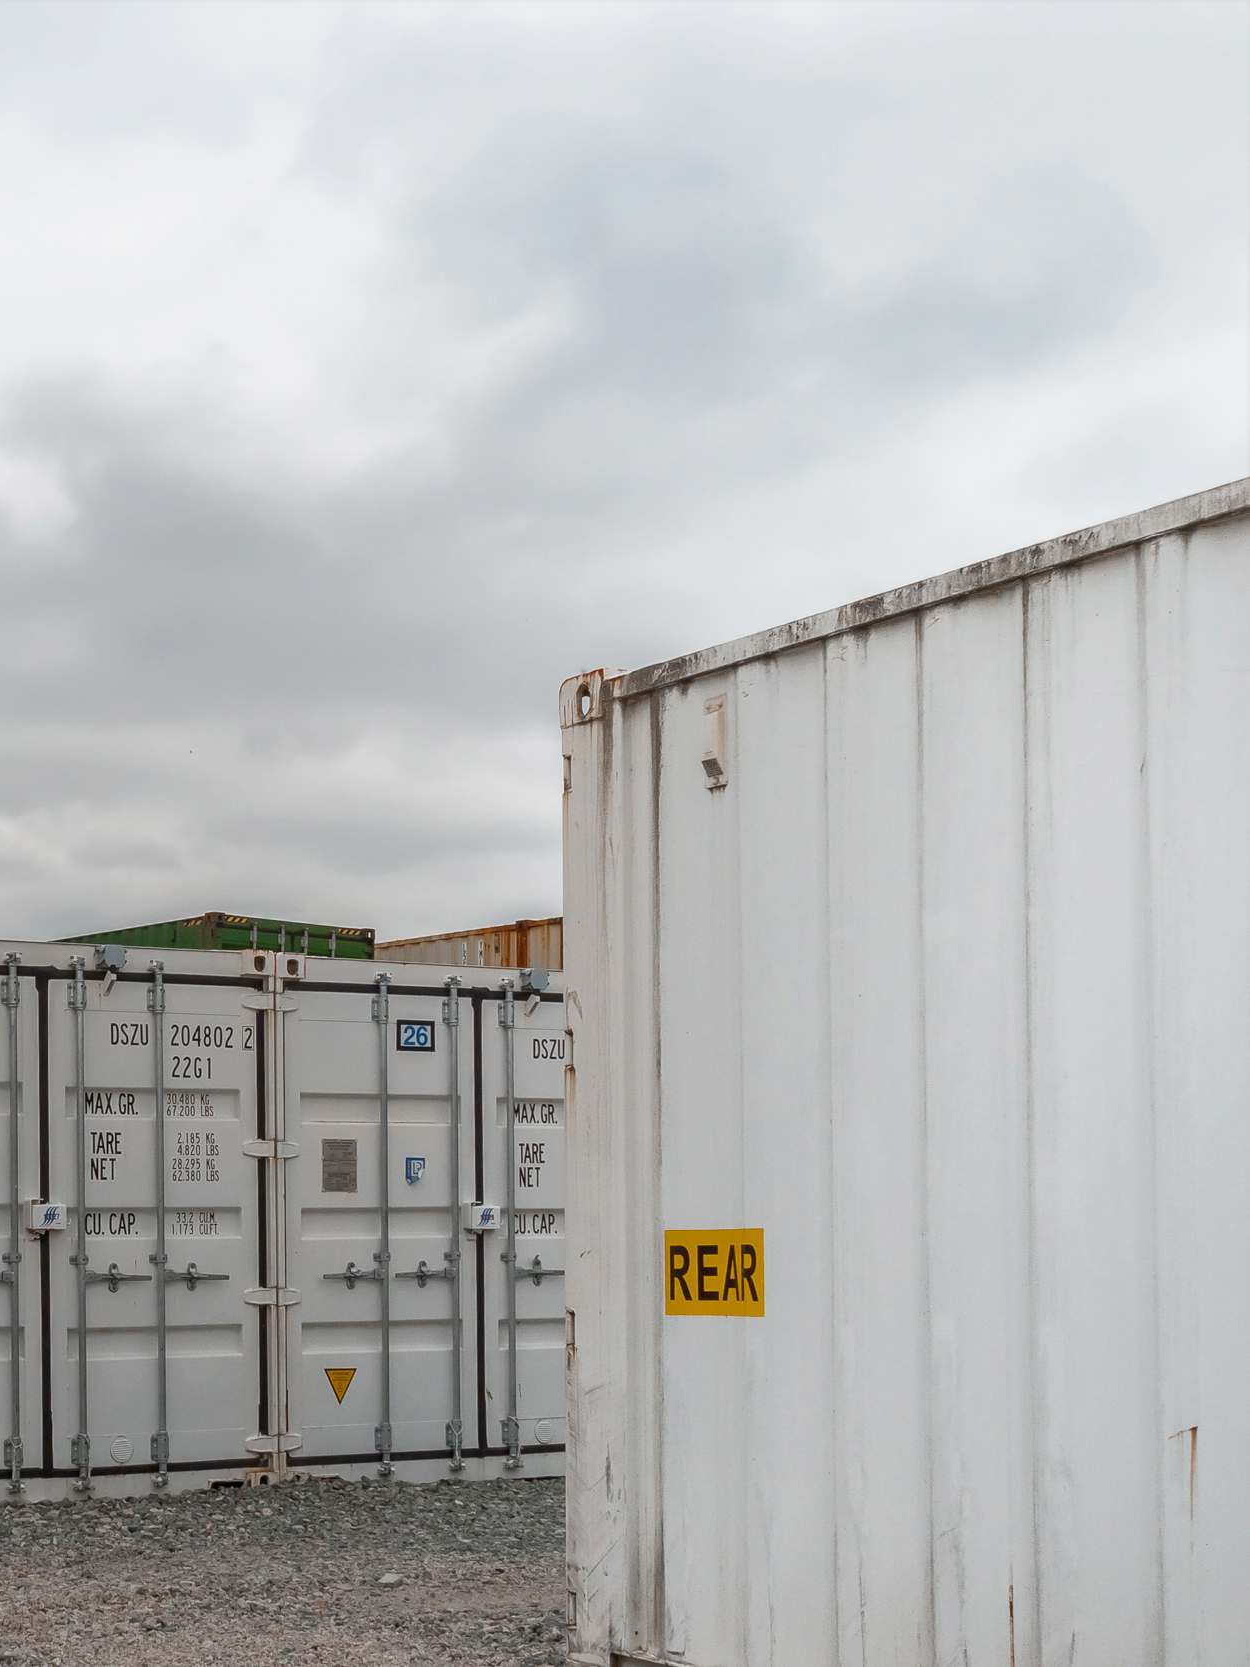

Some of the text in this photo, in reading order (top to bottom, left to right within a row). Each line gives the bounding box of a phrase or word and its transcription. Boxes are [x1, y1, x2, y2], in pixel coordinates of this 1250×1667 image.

[110, 1022, 149, 1046] DSZU
[170, 1024, 234, 1048] 204802
[403, 1025, 429, 1047] 26
[532, 1038, 565, 1060] DSZU
[171, 1056, 212, 1079] 22G1
[200, 1093, 210, 1105] KG
[200, 1105, 214, 1117] LBS
[90, 1132, 215, 1155] TARE 2.185 KG
[177, 1144, 220, 1156] 4.820 LBS
[518, 1143, 546, 1164] TARE
[90, 1158, 216, 1180] NET 28.295 KG
[172, 1170, 220, 1182] 62.380 LBS
[519, 1167, 541, 1188] NET
[176, 1212, 194, 1223] 33.2
[669, 1244, 759, 1302] REAR
